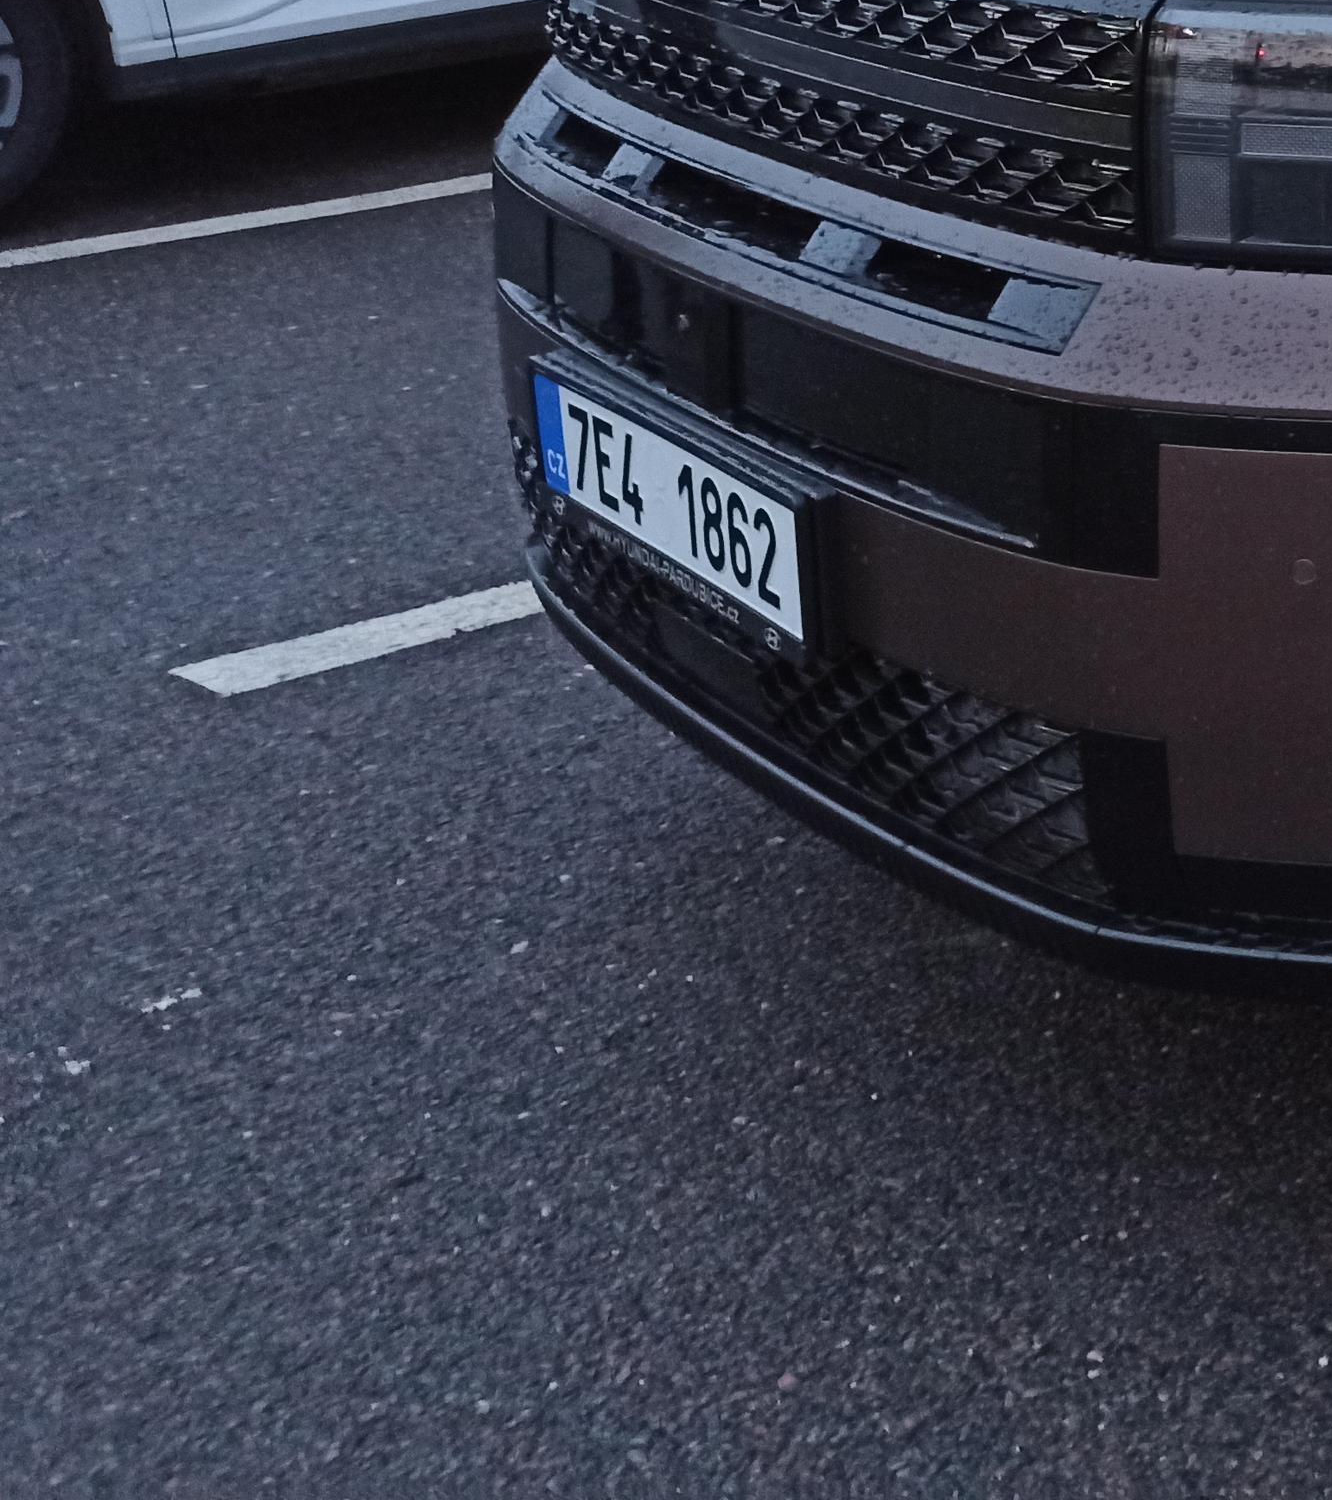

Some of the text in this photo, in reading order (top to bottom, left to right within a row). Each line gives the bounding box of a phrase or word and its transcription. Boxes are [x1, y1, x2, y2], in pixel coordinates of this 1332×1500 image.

[547, 449, 567, 479] CZ
[568, 403, 781, 610] 7E4 1862
